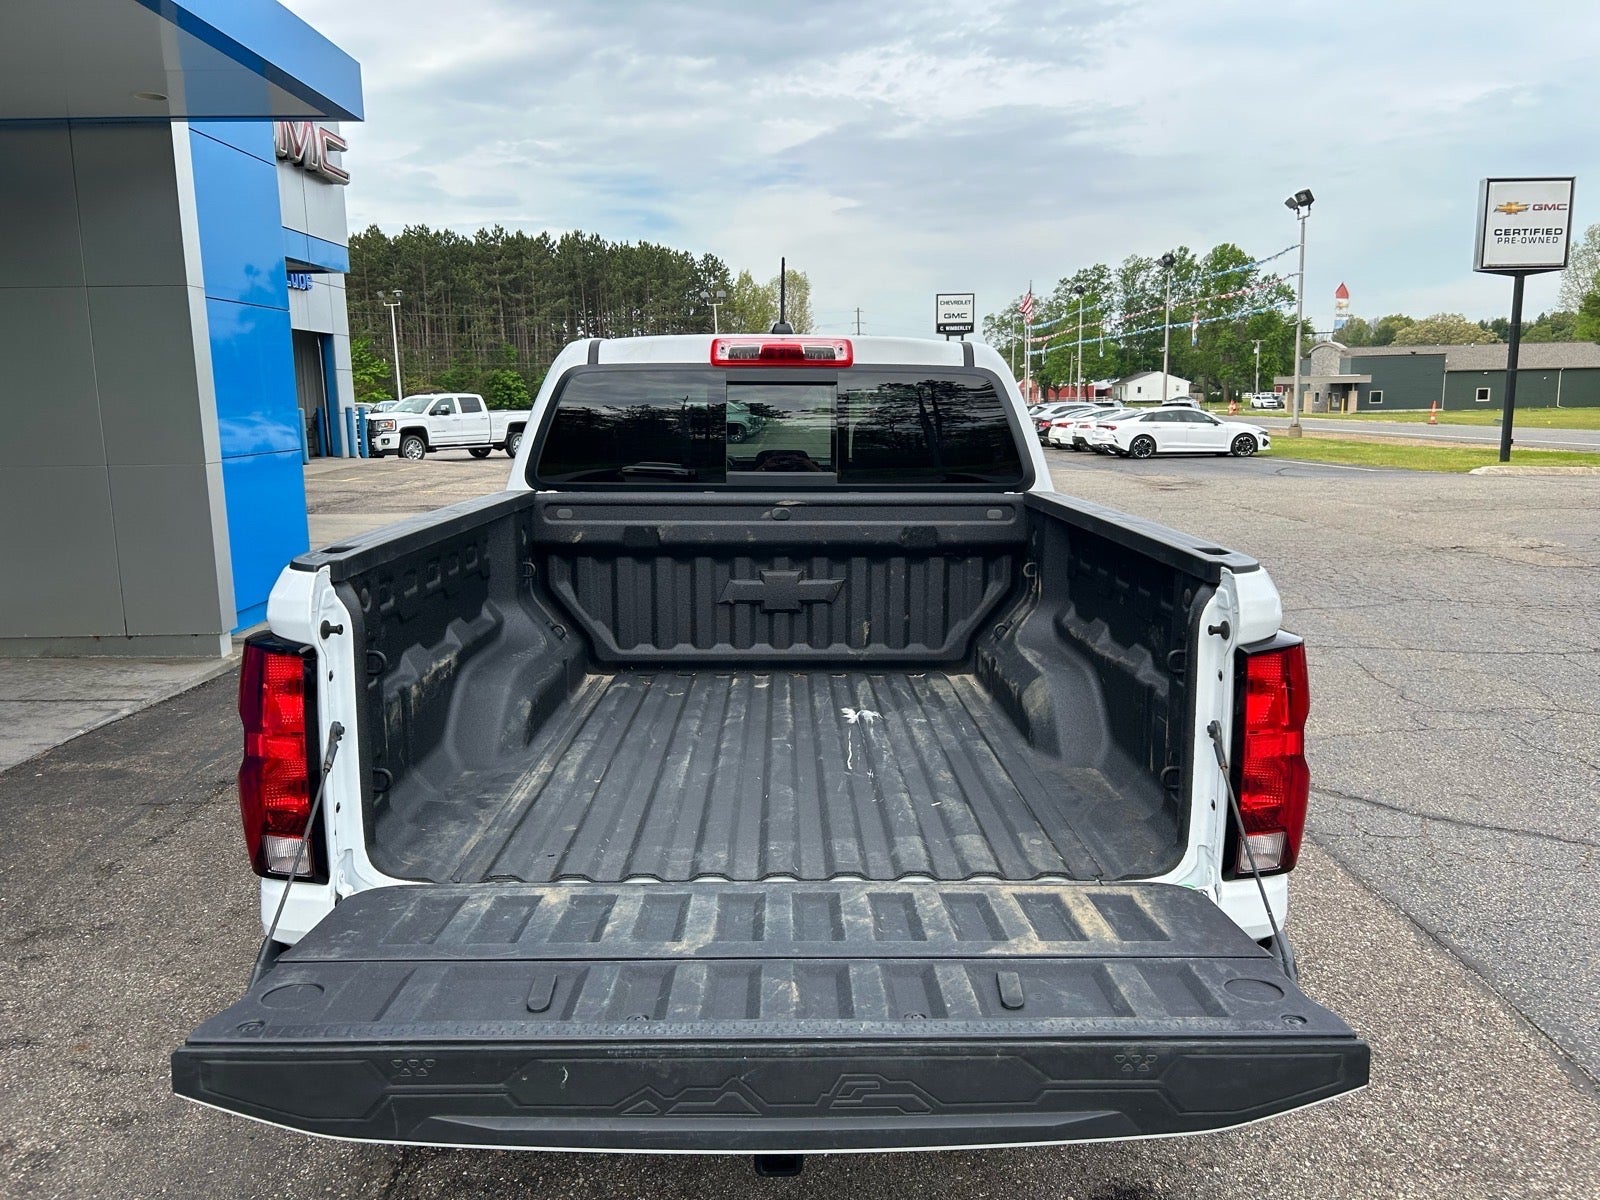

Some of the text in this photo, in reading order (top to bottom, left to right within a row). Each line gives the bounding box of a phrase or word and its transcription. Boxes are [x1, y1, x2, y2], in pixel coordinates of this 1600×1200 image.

[275, 121, 350, 185] MC
[1532, 203, 1568, 211] GMC
[1494, 228, 1563, 236] CERTIFIED
[1497, 236, 1559, 244] PRE-OWNED
